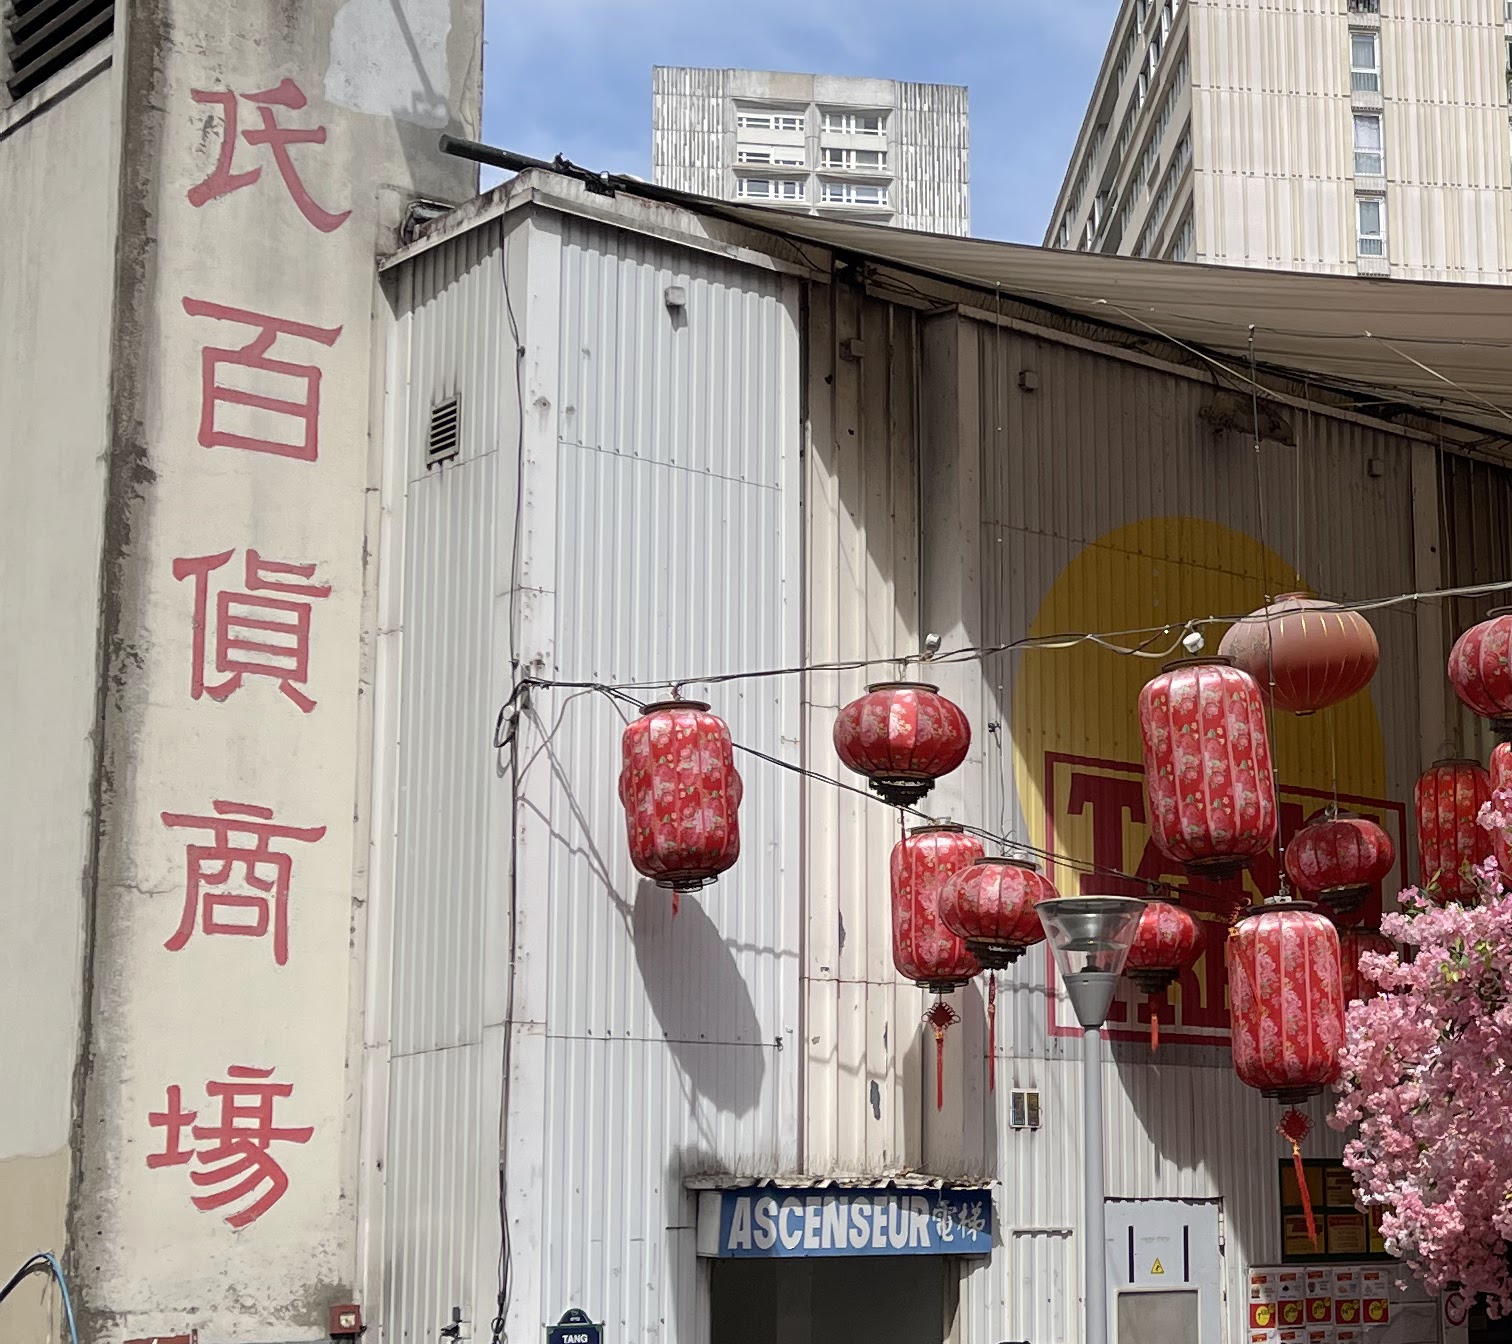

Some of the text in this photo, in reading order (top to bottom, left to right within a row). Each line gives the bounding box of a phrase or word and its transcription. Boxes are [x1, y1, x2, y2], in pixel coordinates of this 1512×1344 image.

[727, 1195, 931, 1250] ASCENSEUR
[932, 1199, 986, 1243] 電梯
[562, 1334, 588, 1344] TANG
